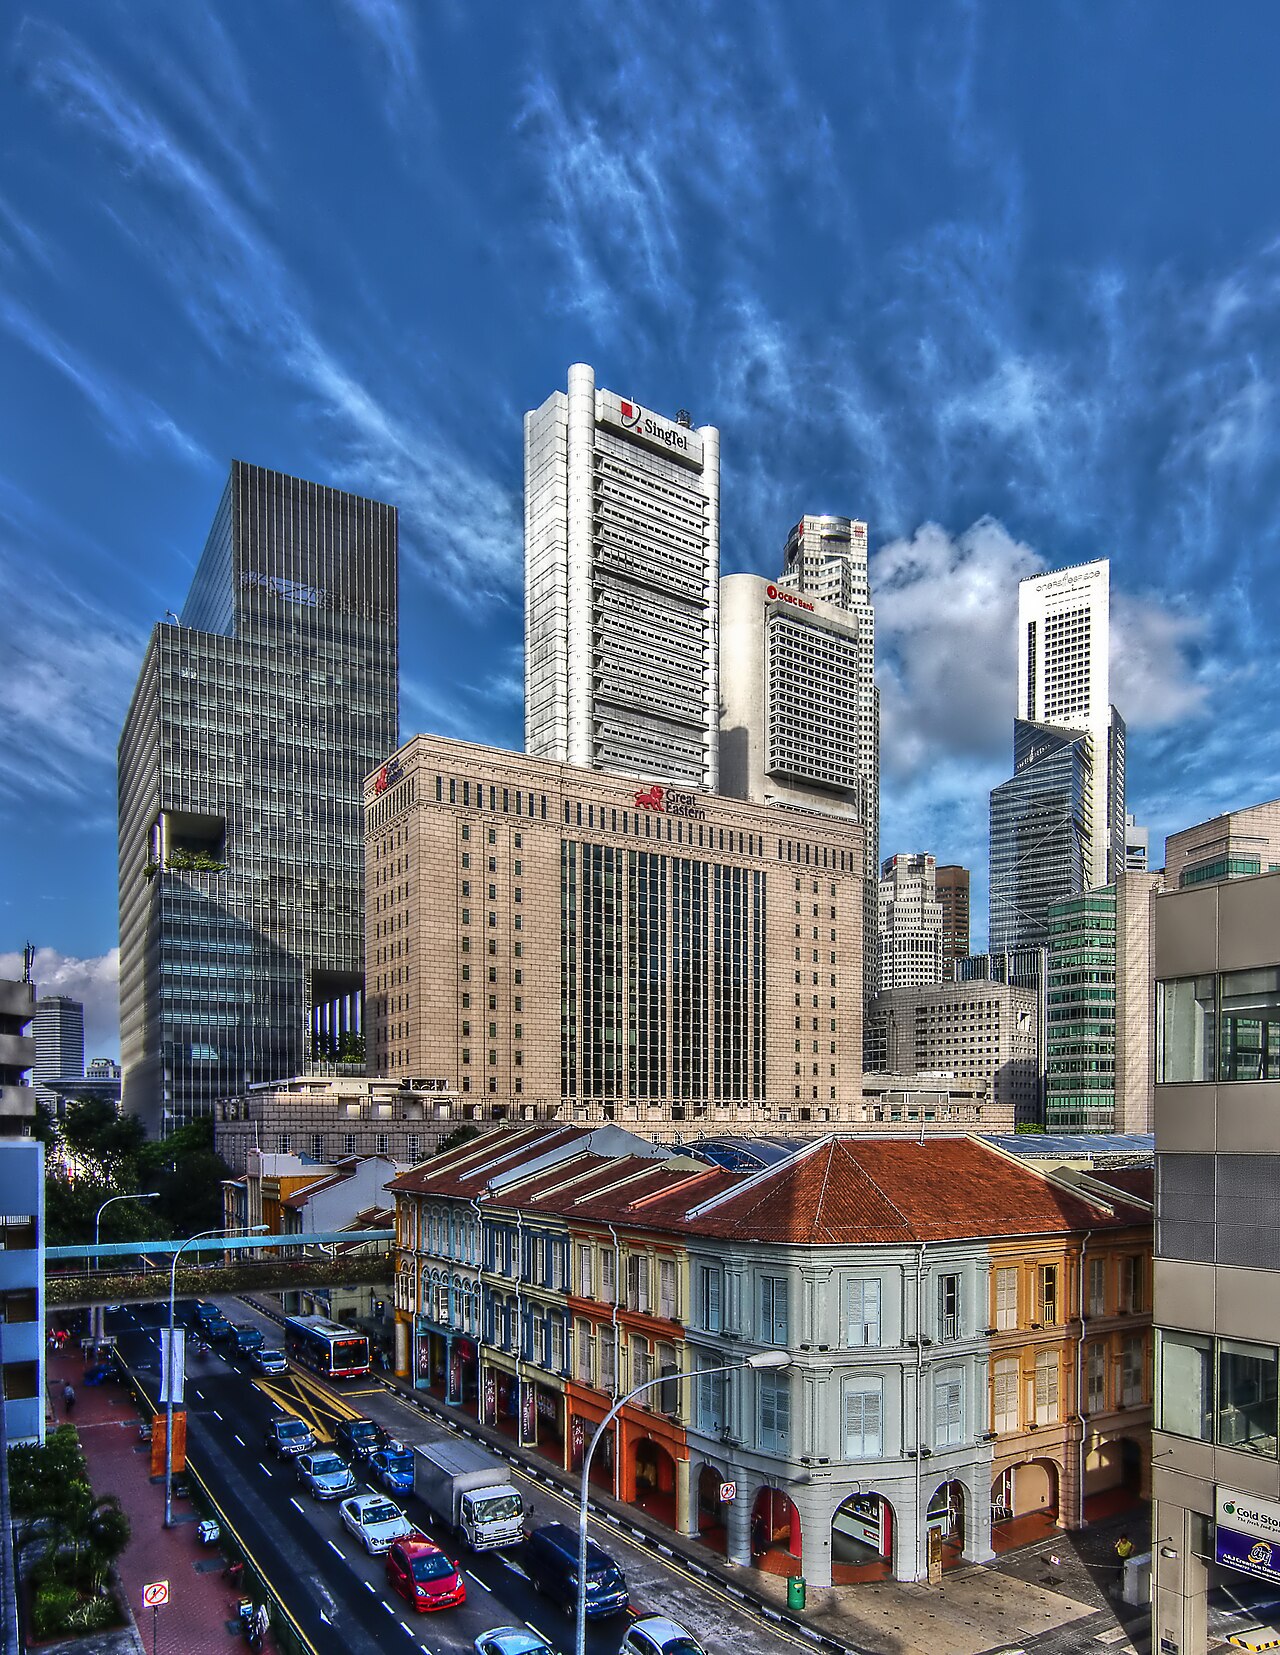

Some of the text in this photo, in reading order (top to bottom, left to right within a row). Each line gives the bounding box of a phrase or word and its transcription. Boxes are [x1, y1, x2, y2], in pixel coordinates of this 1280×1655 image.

[645, 418, 688, 451] SingTel
[778, 591, 815, 612] OCBC Bank
[666, 788, 697, 806] Great
[665, 801, 706, 819] Eastern
[1236, 1507, 1280, 1527] Cold Sto
